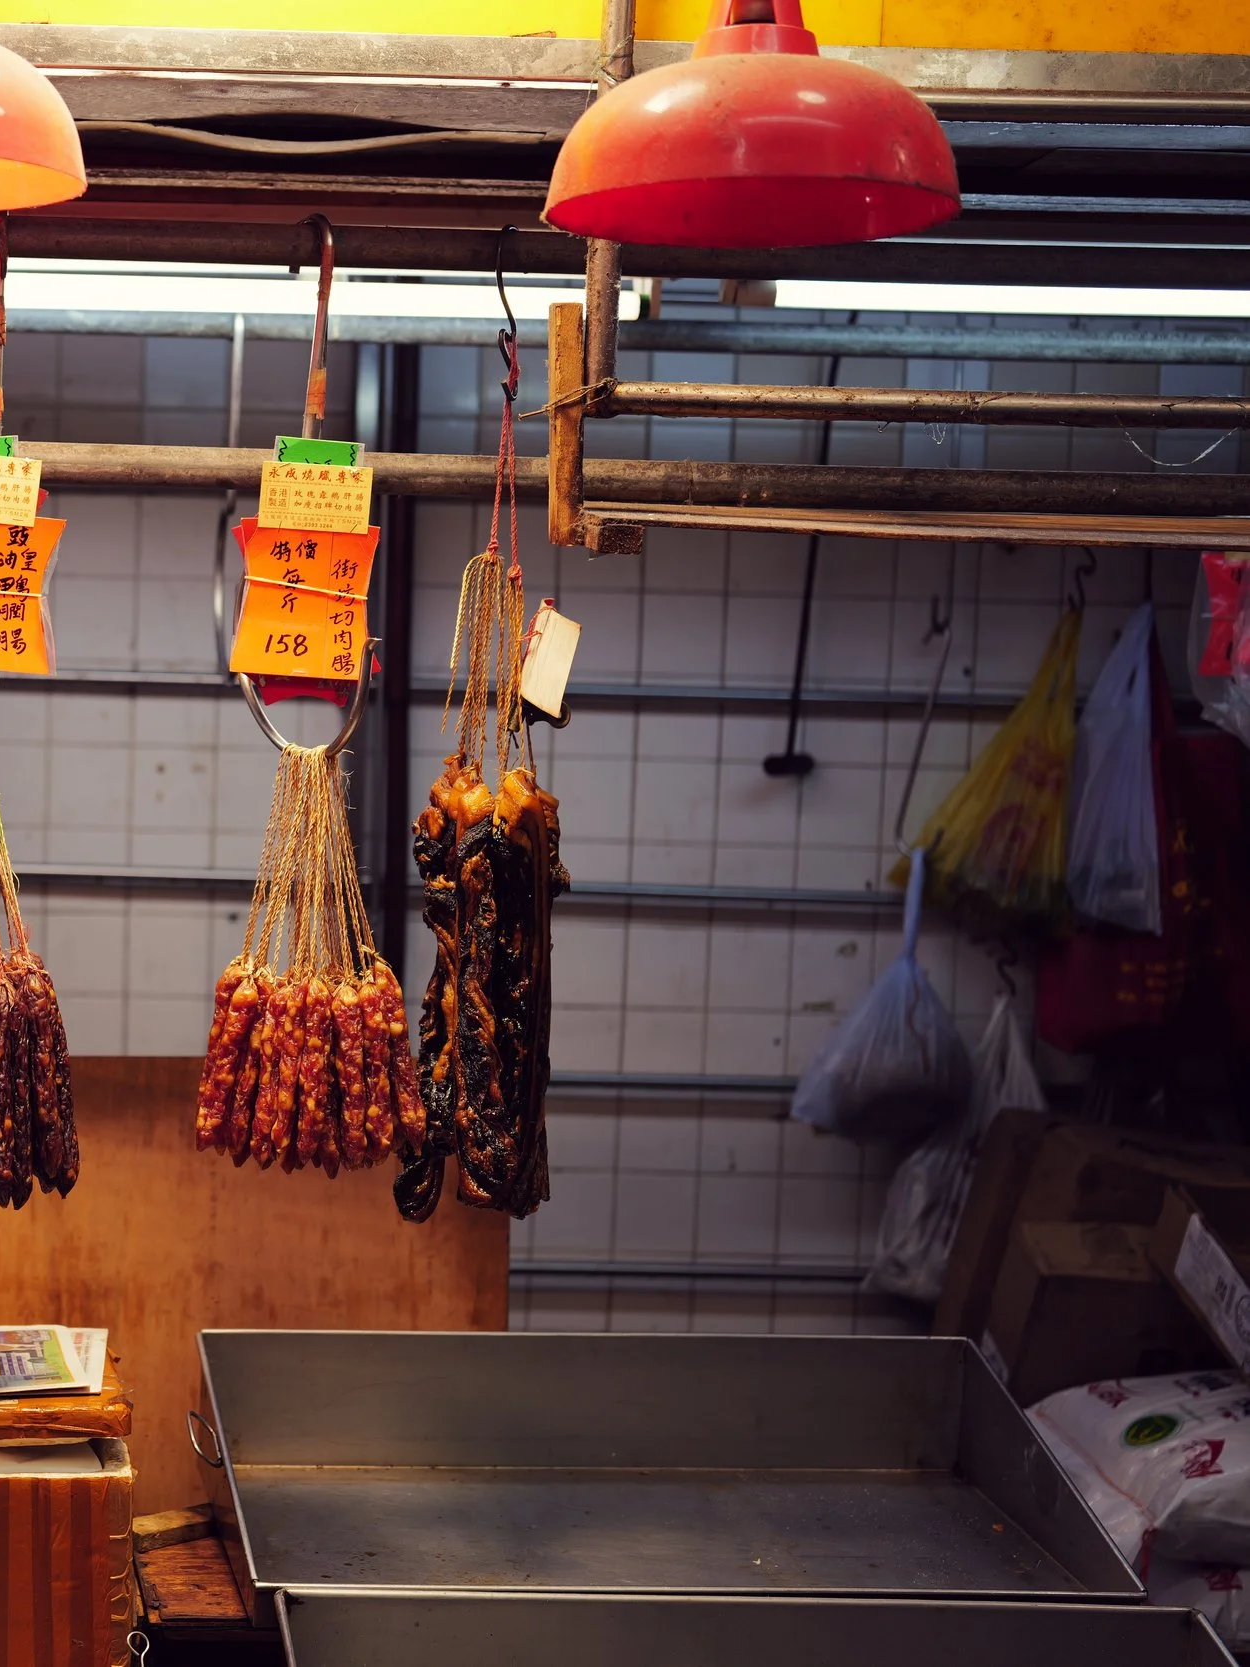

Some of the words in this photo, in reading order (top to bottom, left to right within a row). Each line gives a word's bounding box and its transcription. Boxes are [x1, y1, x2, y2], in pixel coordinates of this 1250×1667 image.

[270, 539, 318, 563] 特價
[280, 568, 305, 613] 每斤
[265, 633, 309, 657] 158
